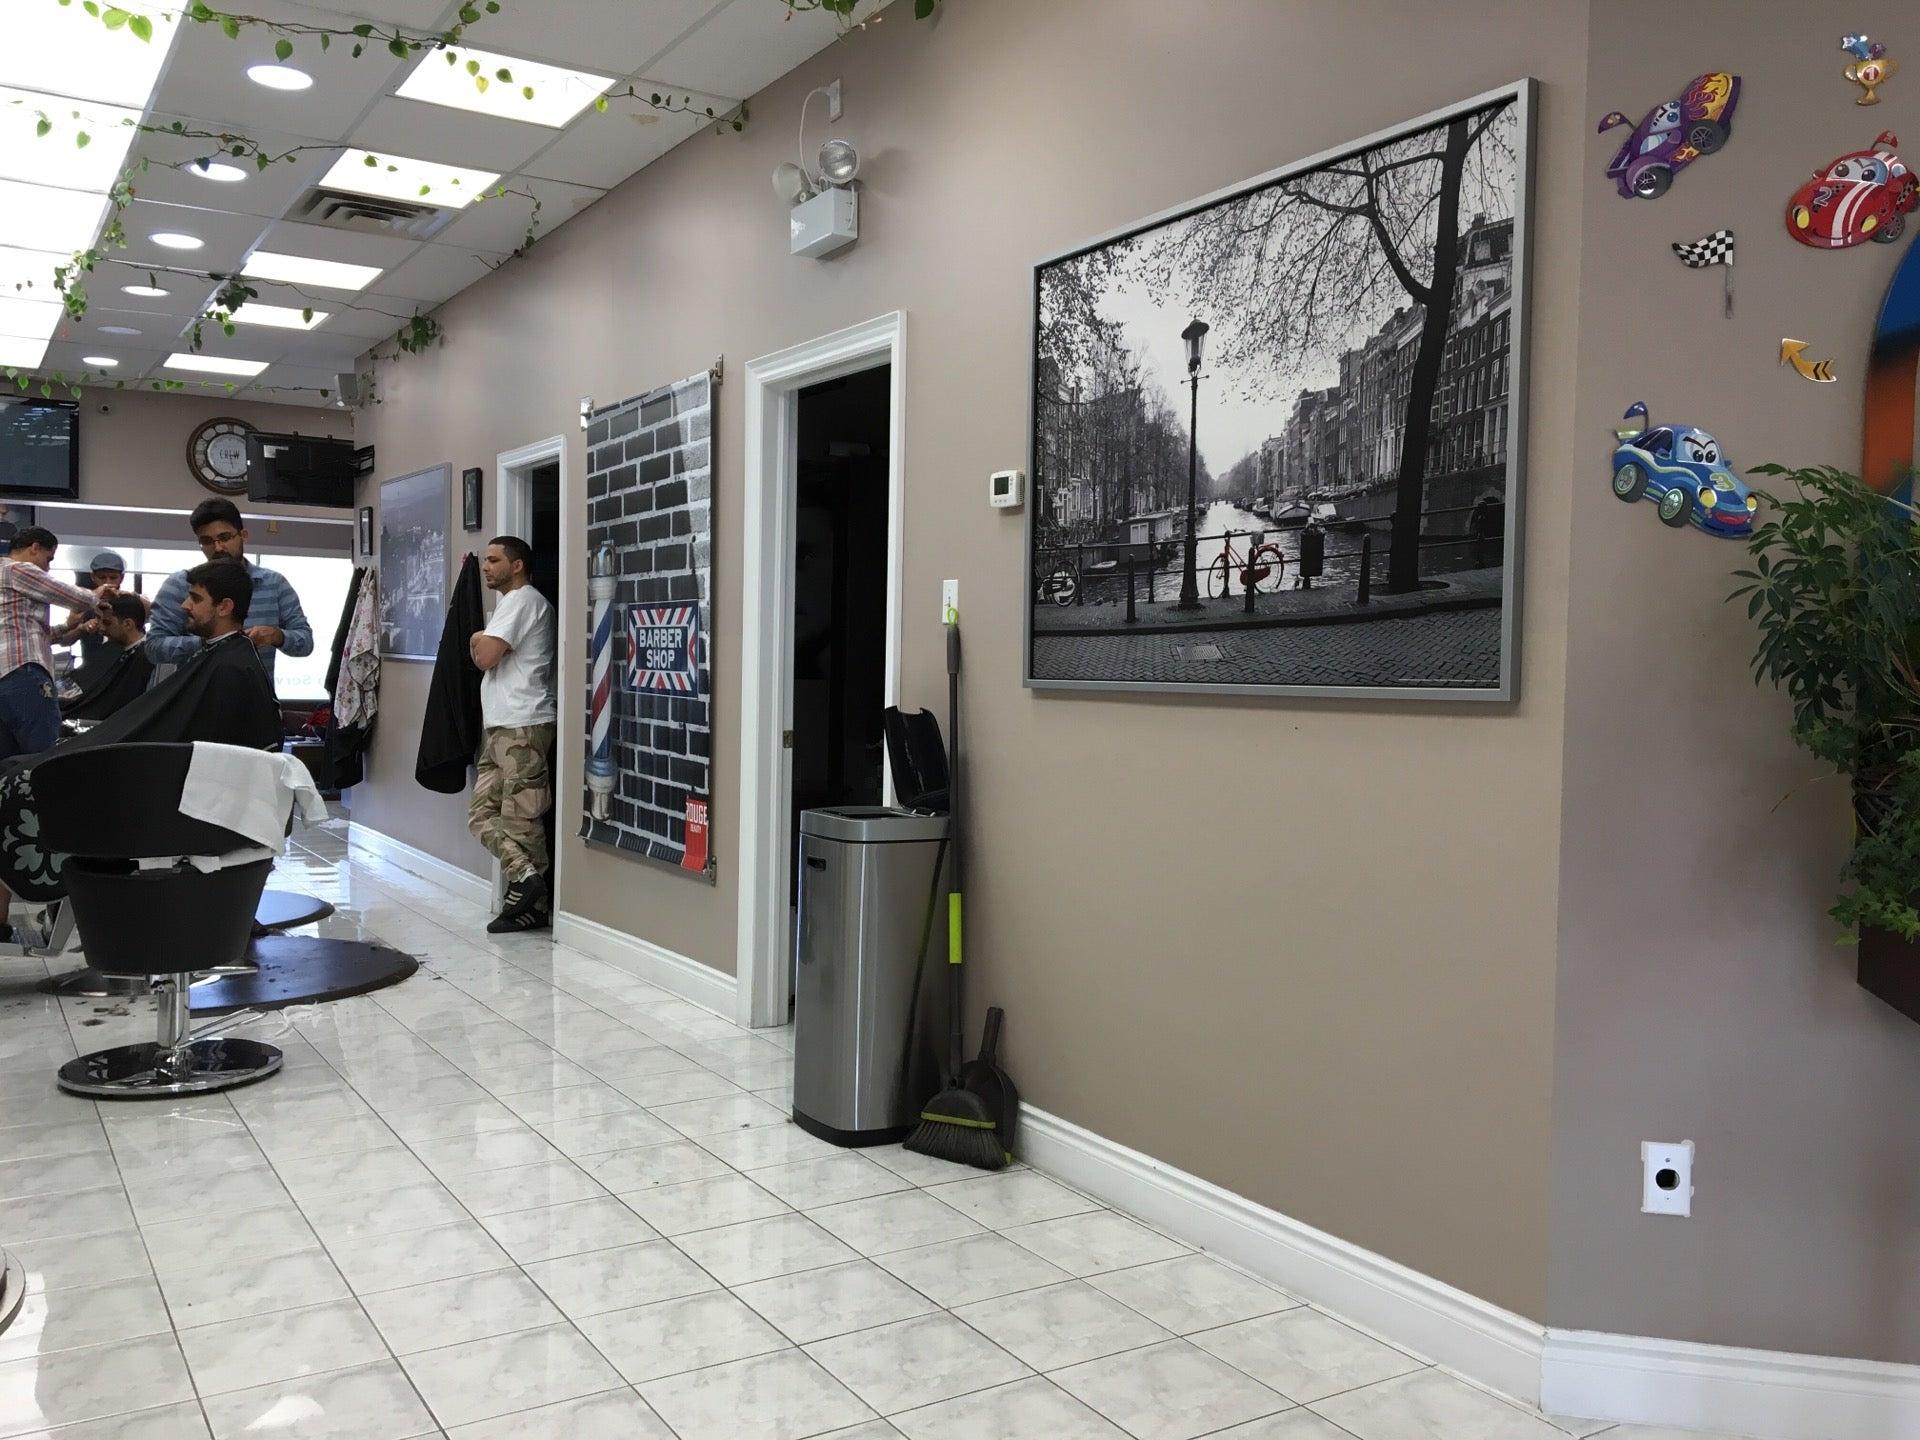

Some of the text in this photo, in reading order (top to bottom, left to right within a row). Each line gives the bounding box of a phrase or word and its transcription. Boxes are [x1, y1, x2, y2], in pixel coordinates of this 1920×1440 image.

[1813, 186, 1833, 207] 2
[639, 628, 683, 648] BARBER
[646, 649, 676, 669] SHOP
